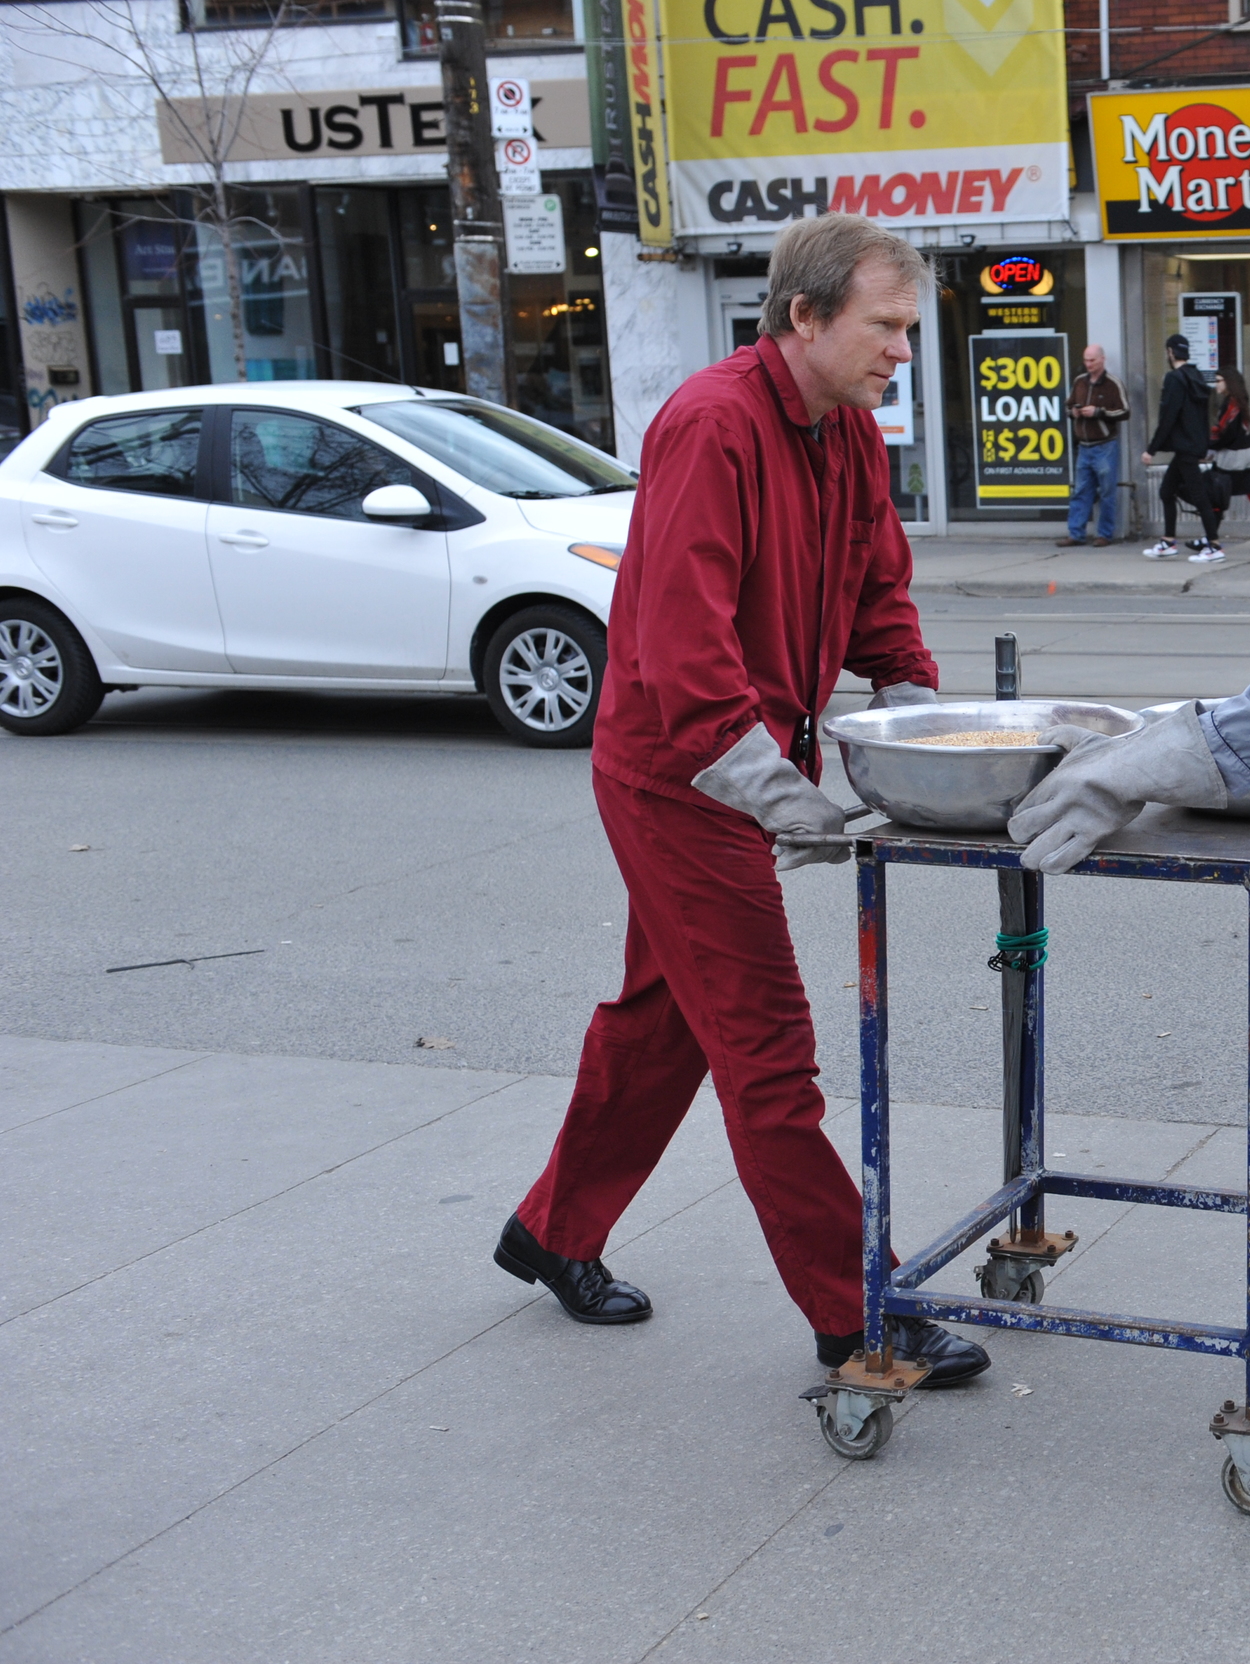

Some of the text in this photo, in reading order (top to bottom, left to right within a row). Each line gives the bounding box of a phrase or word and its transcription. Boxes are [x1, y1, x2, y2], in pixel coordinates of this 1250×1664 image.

[710, 46, 926, 137] FAST.
[990, 263, 1041, 282] OPEN
[987, 307, 1039, 316] WESTERN
[1003, 315, 1039, 324] UNION
[979, 356, 1061, 391] $300
[980, 395, 1060, 422] LOAN
[997, 428, 1064, 462] $20
